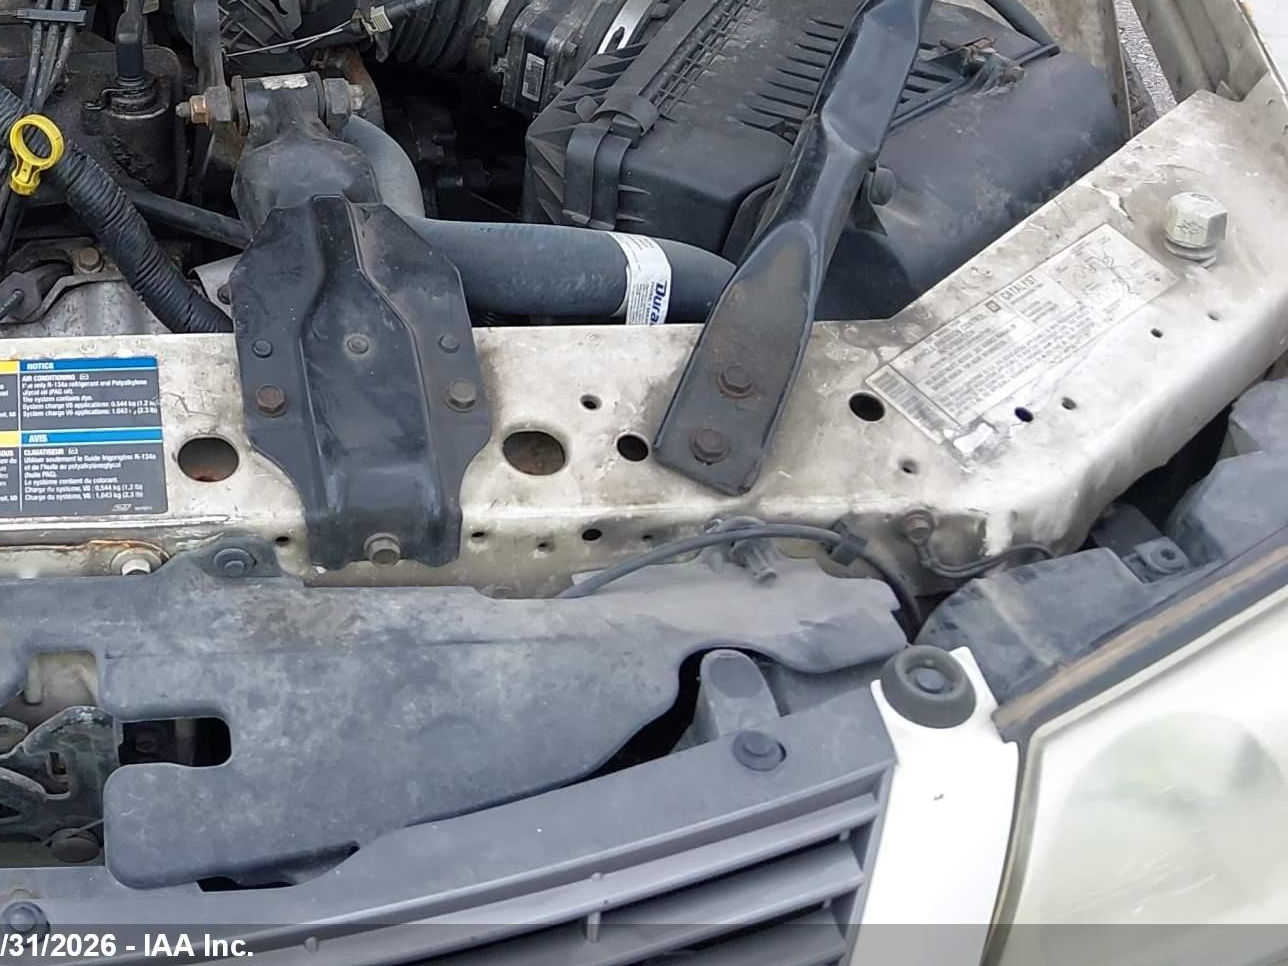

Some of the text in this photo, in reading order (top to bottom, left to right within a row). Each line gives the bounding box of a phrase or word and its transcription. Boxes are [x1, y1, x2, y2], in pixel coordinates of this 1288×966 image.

[999, 274, 1037, 301] CATALYST
[649, 279, 667, 326] Dura
[26, 362, 54, 370] NOTICE
[29, 434, 48, 442] AVIS
